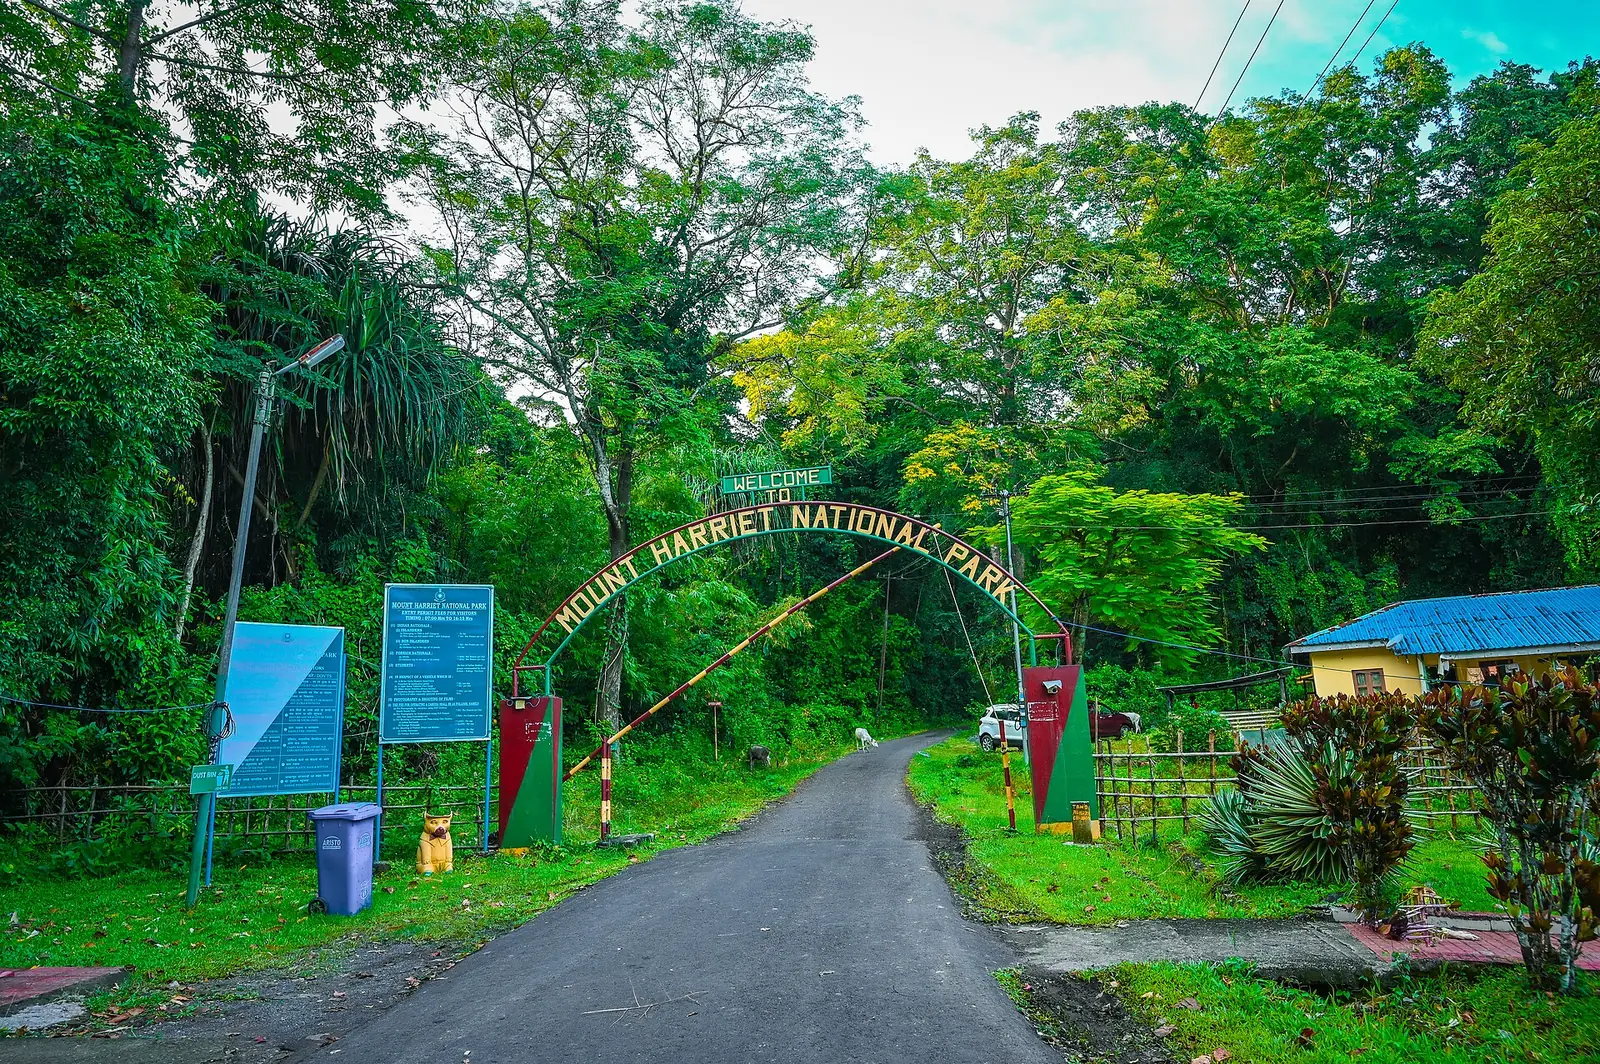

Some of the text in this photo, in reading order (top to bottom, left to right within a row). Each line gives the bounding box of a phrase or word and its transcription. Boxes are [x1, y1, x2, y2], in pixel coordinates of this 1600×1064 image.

[734, 469, 820, 491] WELCOME
[766, 488, 790, 503] TO
[555, 504, 1020, 634] MOUNT HARRIET NATIONAL PARK
[441, 602, 470, 610] NATIONAL
